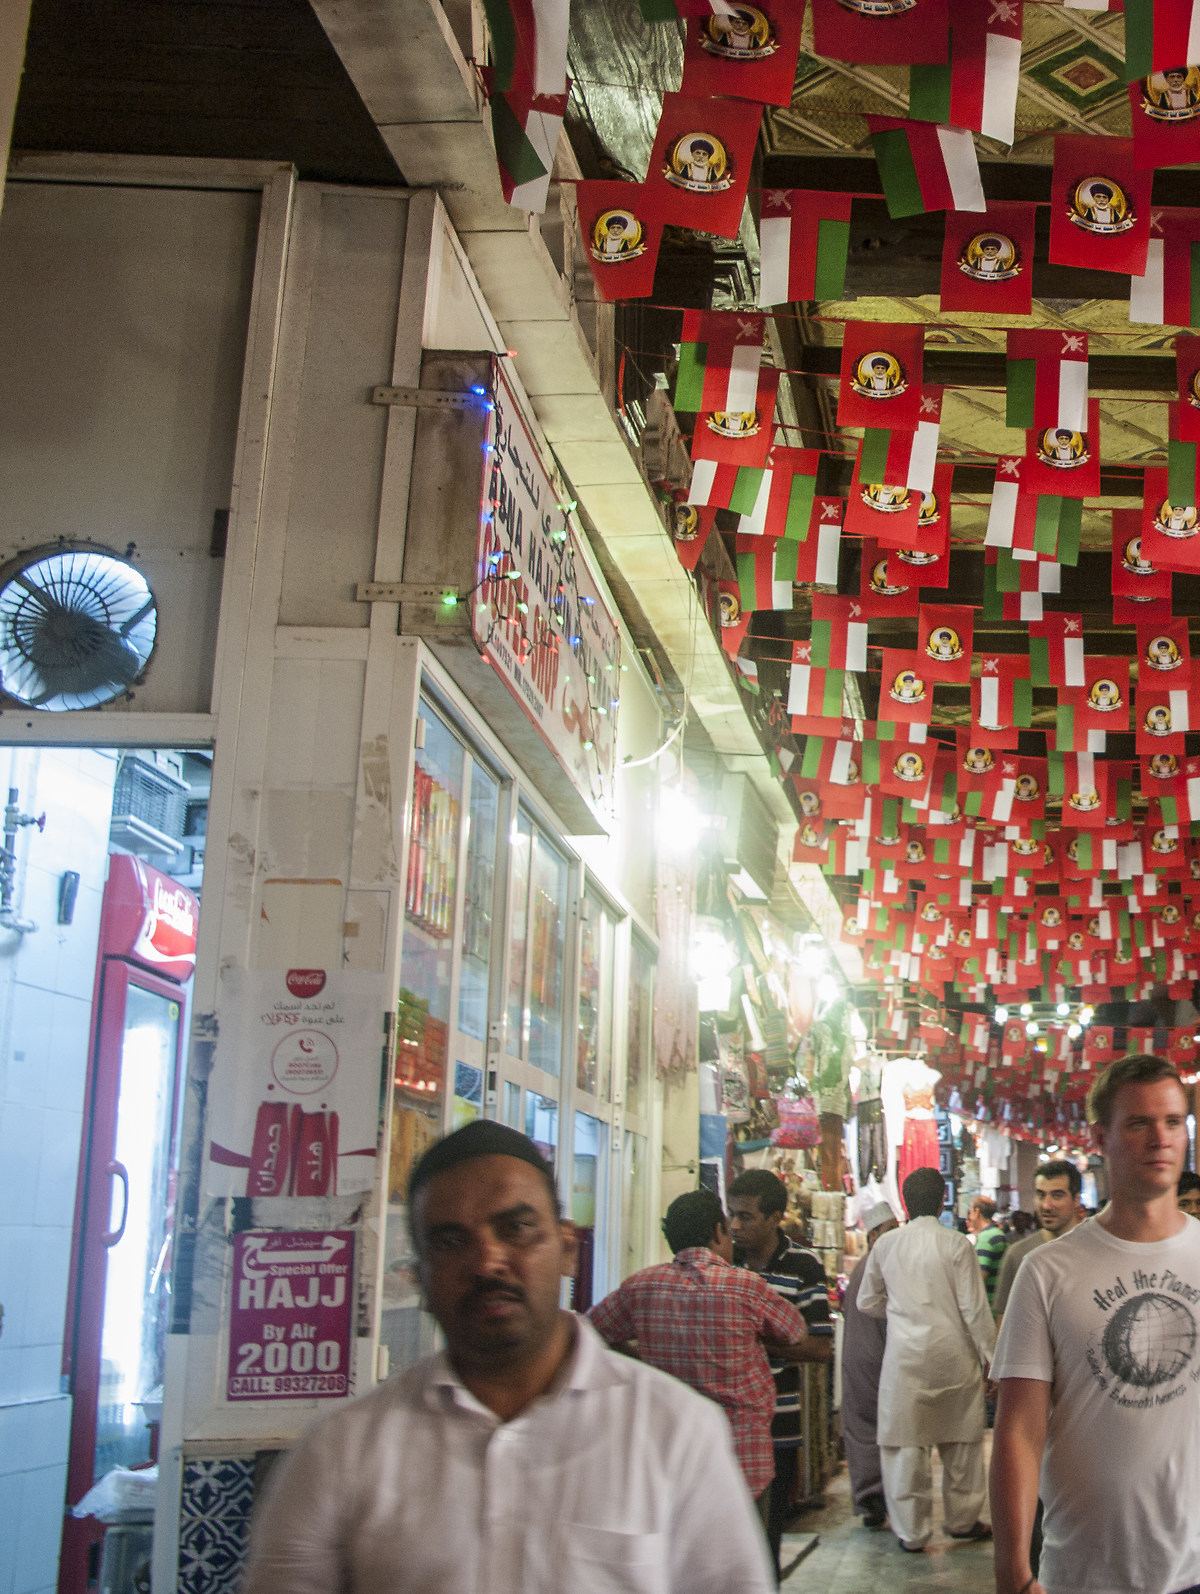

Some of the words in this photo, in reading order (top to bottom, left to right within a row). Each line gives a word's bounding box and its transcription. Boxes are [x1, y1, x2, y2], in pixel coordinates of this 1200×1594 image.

[488, 459, 523, 558] ABNA
[531, 604, 559, 712] SHOP
[257, 1123, 281, 1192] حمدان
[269, 1264, 316, 1277] Special
[318, 1263, 348, 1275] Offer
[238, 1276, 347, 1310] HAJJ
[1092, 1276, 1129, 1311] Heal
[1132, 1268, 1158, 1291] the
[262, 1323, 286, 1341] By
[290, 1322, 318, 1340] Air
[236, 1340, 341, 1375] 2000
[231, 1377, 270, 1395] CALL:
[273, 1375, 346, 1393] 99327208
